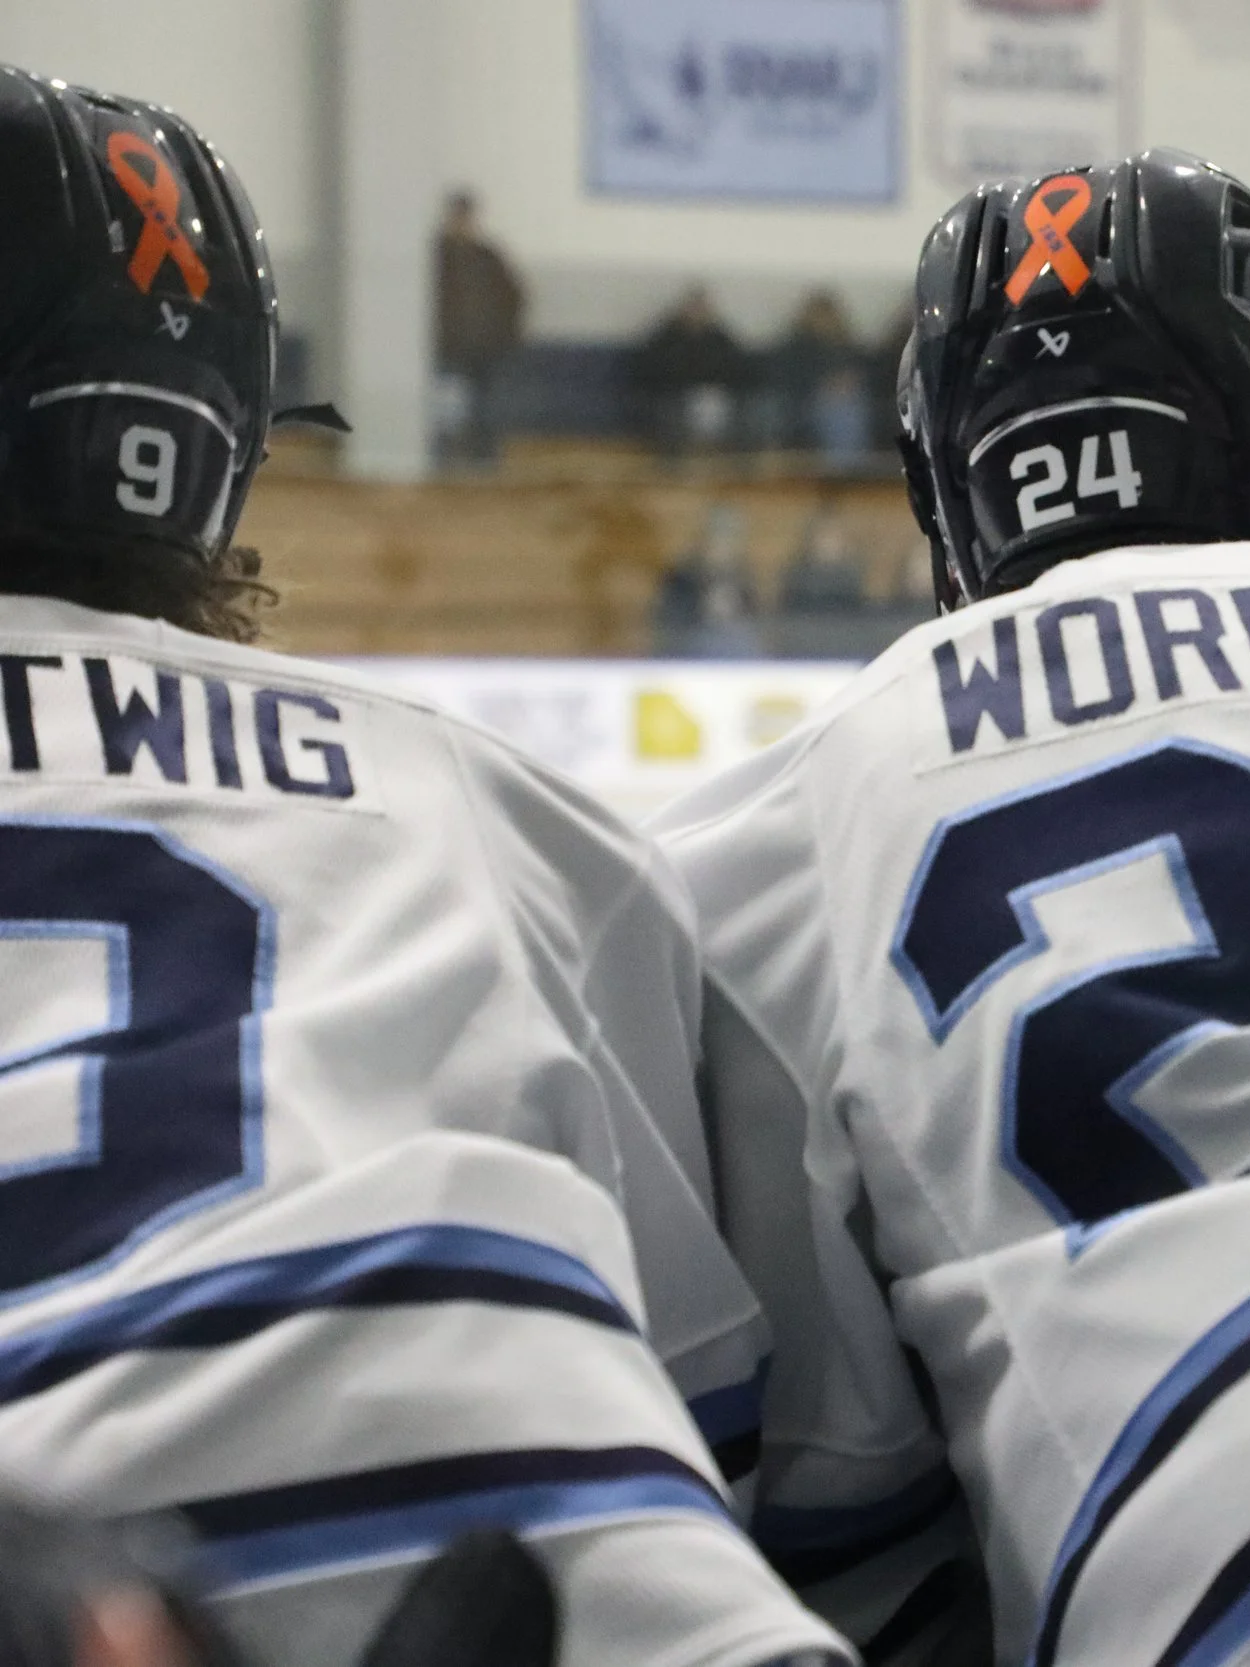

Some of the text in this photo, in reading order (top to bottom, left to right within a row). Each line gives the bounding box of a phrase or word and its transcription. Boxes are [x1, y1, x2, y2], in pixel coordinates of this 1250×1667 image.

[116, 424, 178, 518] 9
[1009, 429, 1143, 531] 24
[0, 655, 356, 799] TWIG
